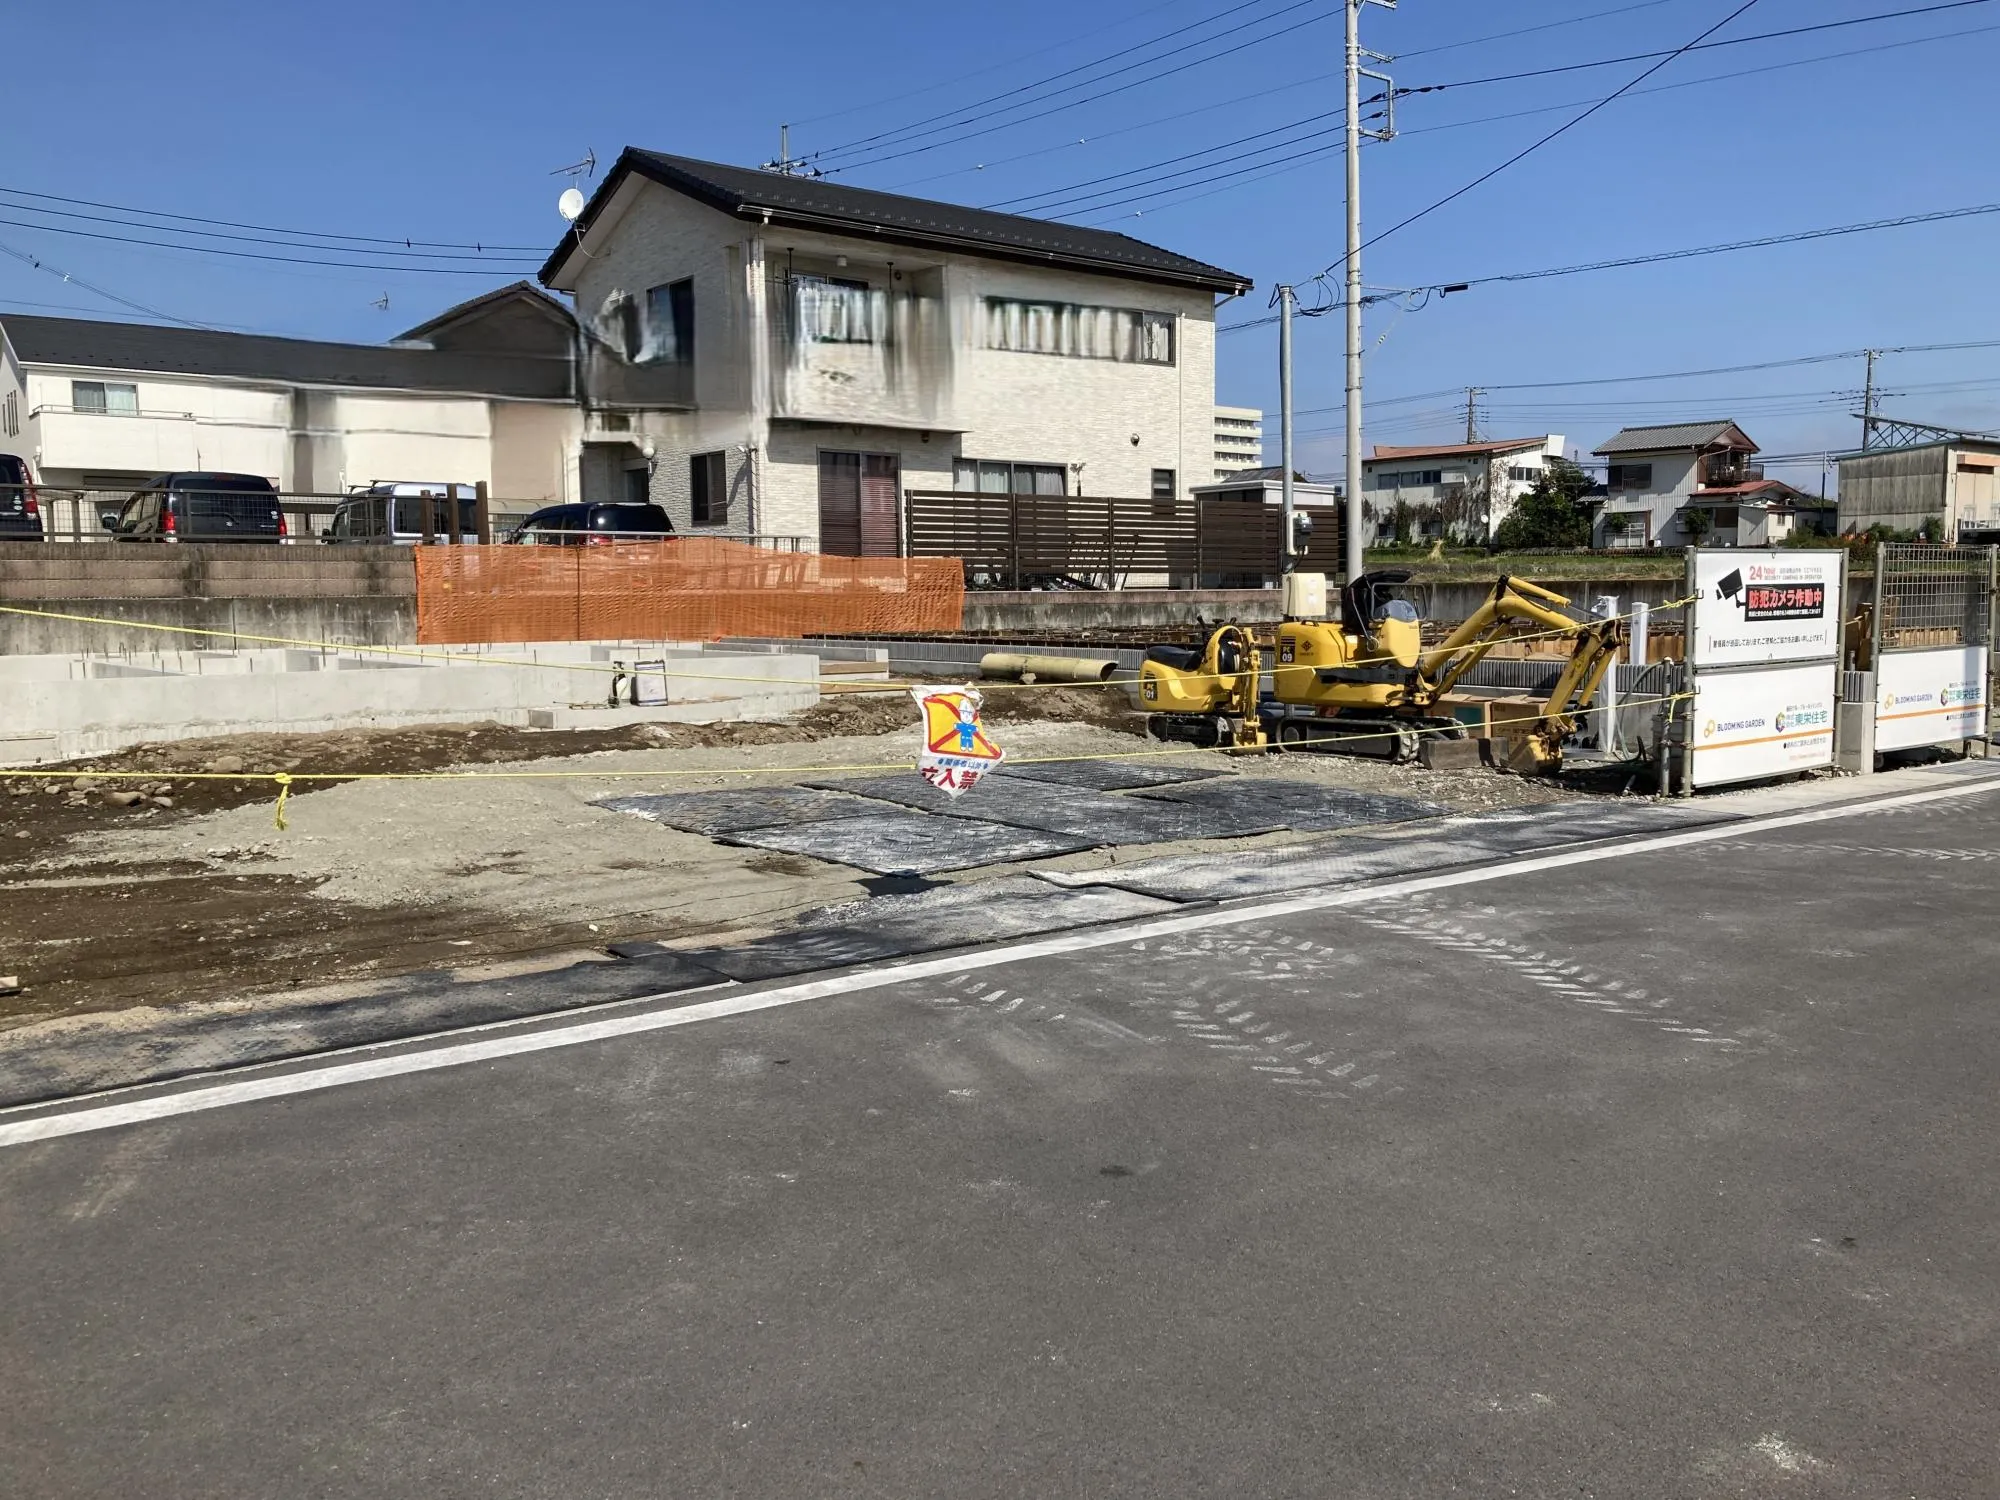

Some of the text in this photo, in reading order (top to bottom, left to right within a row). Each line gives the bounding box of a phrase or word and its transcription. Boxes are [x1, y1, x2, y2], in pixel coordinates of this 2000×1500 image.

[1749, 565, 1762, 580] 24
[1748, 588, 1822, 609] 防犯カメラ作動中
[1282, 653, 1293, 662] 09
[1717, 718, 1765, 731] BLOOMING GARDEN
[1795, 710, 1828, 725] 東栄住宅
